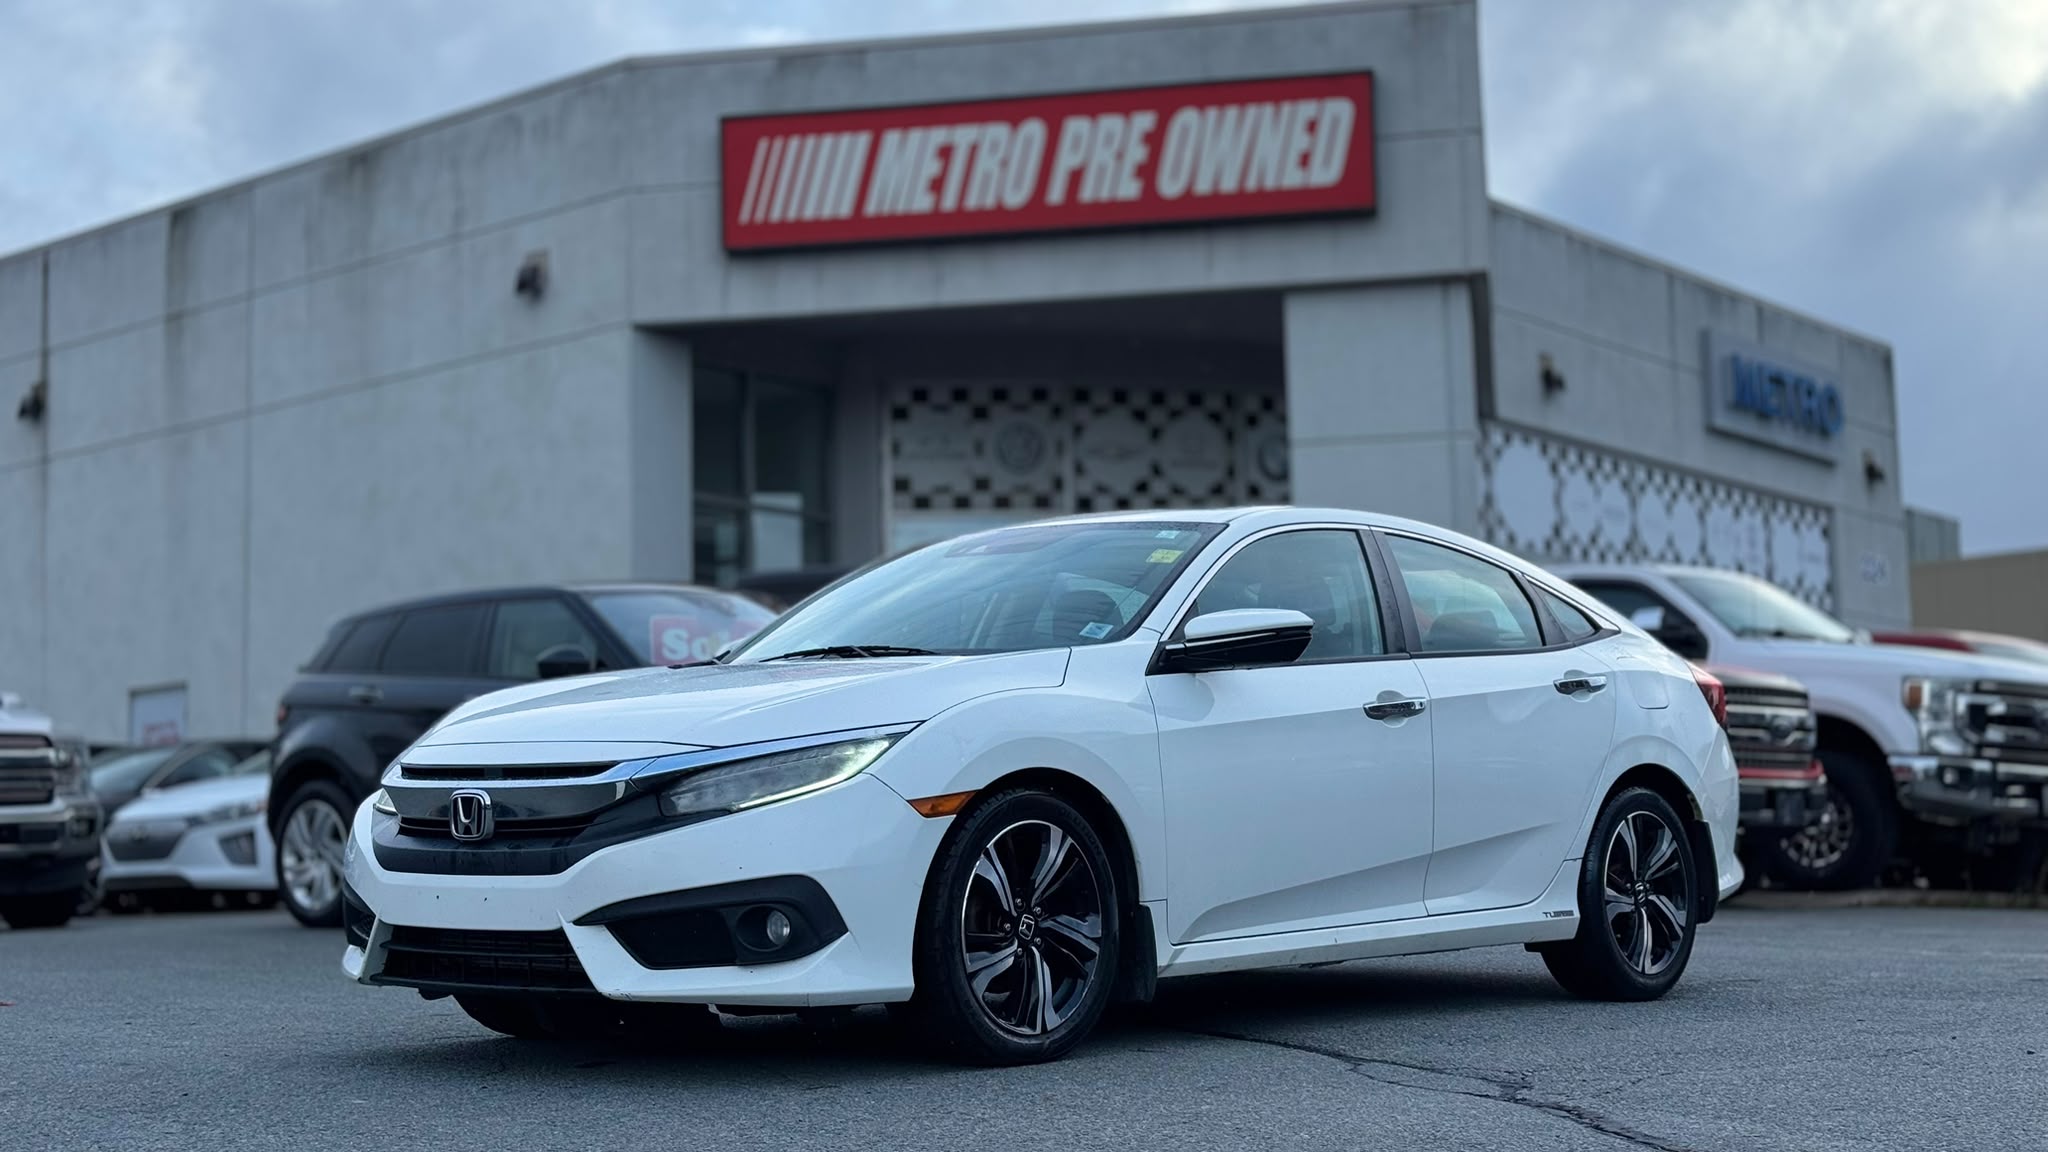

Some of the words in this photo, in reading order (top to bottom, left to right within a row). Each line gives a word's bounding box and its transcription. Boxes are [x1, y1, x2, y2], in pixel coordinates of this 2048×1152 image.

[863, 117, 1047, 217] METRO
[1044, 110, 1158, 206] PRE
[1155, 96, 1356, 200] OWNED
[1731, 354, 1843, 437] METRO
